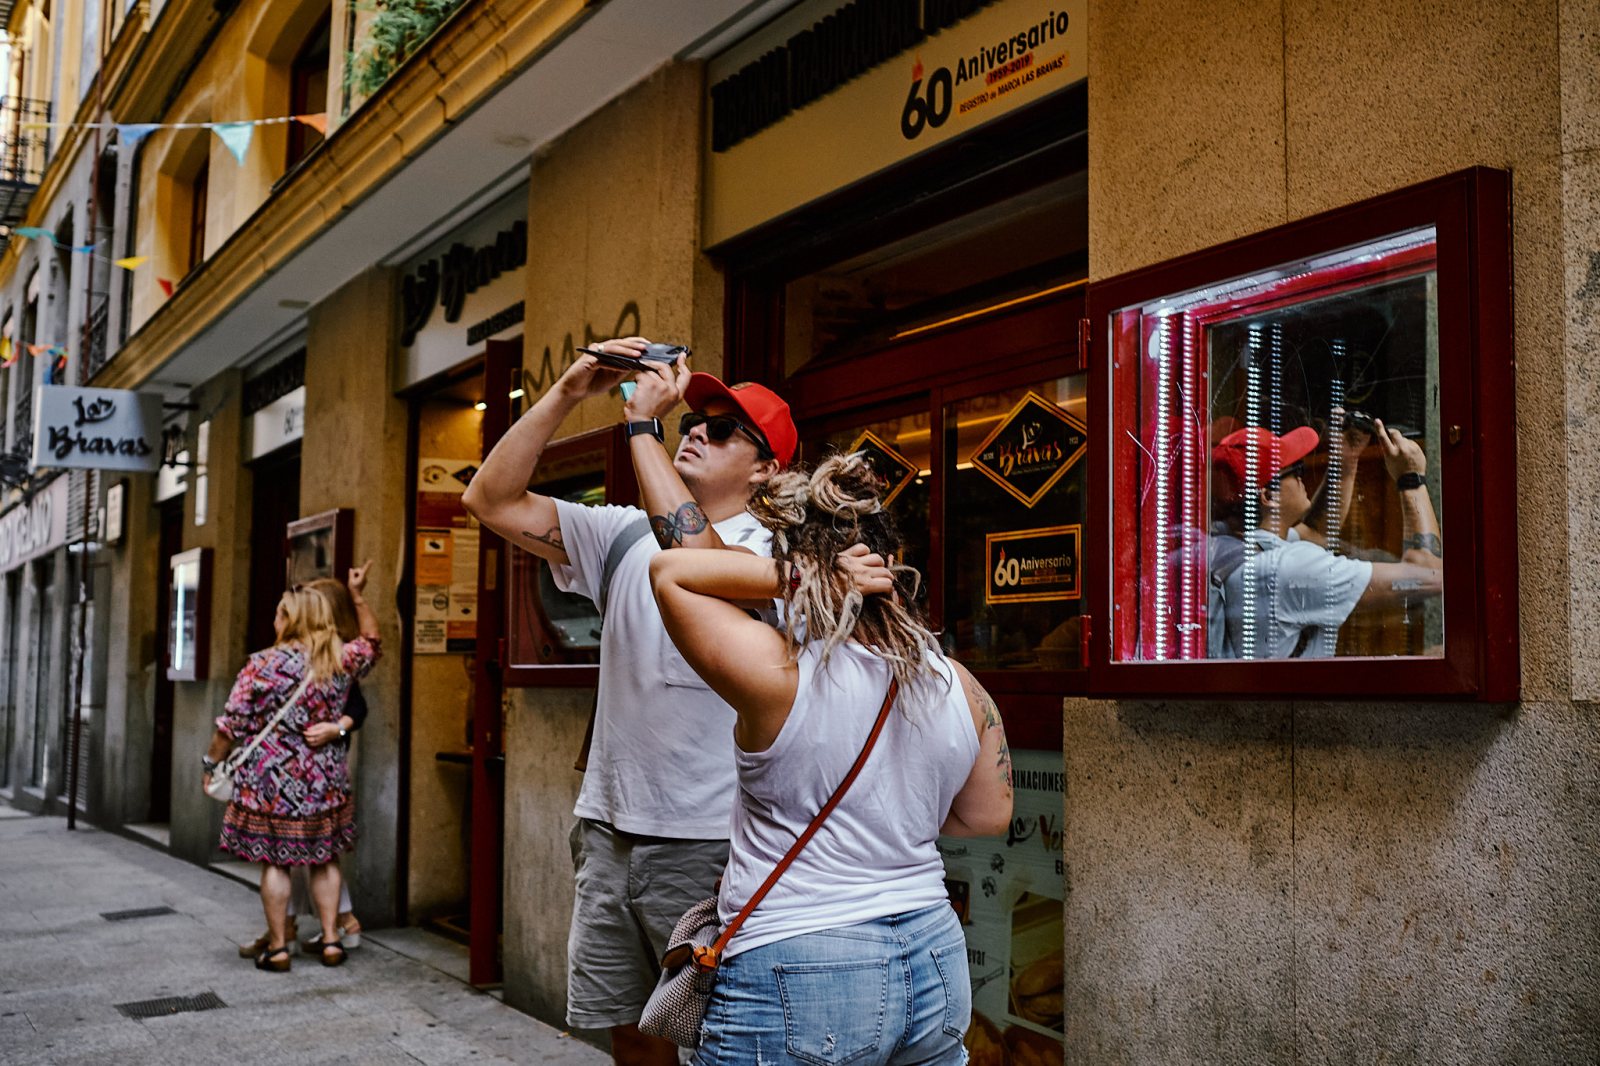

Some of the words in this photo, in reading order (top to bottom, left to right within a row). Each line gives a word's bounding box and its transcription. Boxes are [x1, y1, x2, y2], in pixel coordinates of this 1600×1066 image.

[901, 66, 952, 140] 60
[955, 11, 1069, 86] Aniversario
[988, 54, 1031, 84] 1959-2019
[959, 92, 989, 114] REGISTRO
[997, 77, 1022, 97] MARCA
[1021, 70, 1035, 87] LAS
[72, 395, 117, 427] Las
[48, 424, 153, 460] Bravas
[1021, 421, 1041, 450] Las
[998, 438, 1063, 477] Bravas
[994, 557, 1020, 587] 60
[1020, 552, 1072, 571] Aniversario
